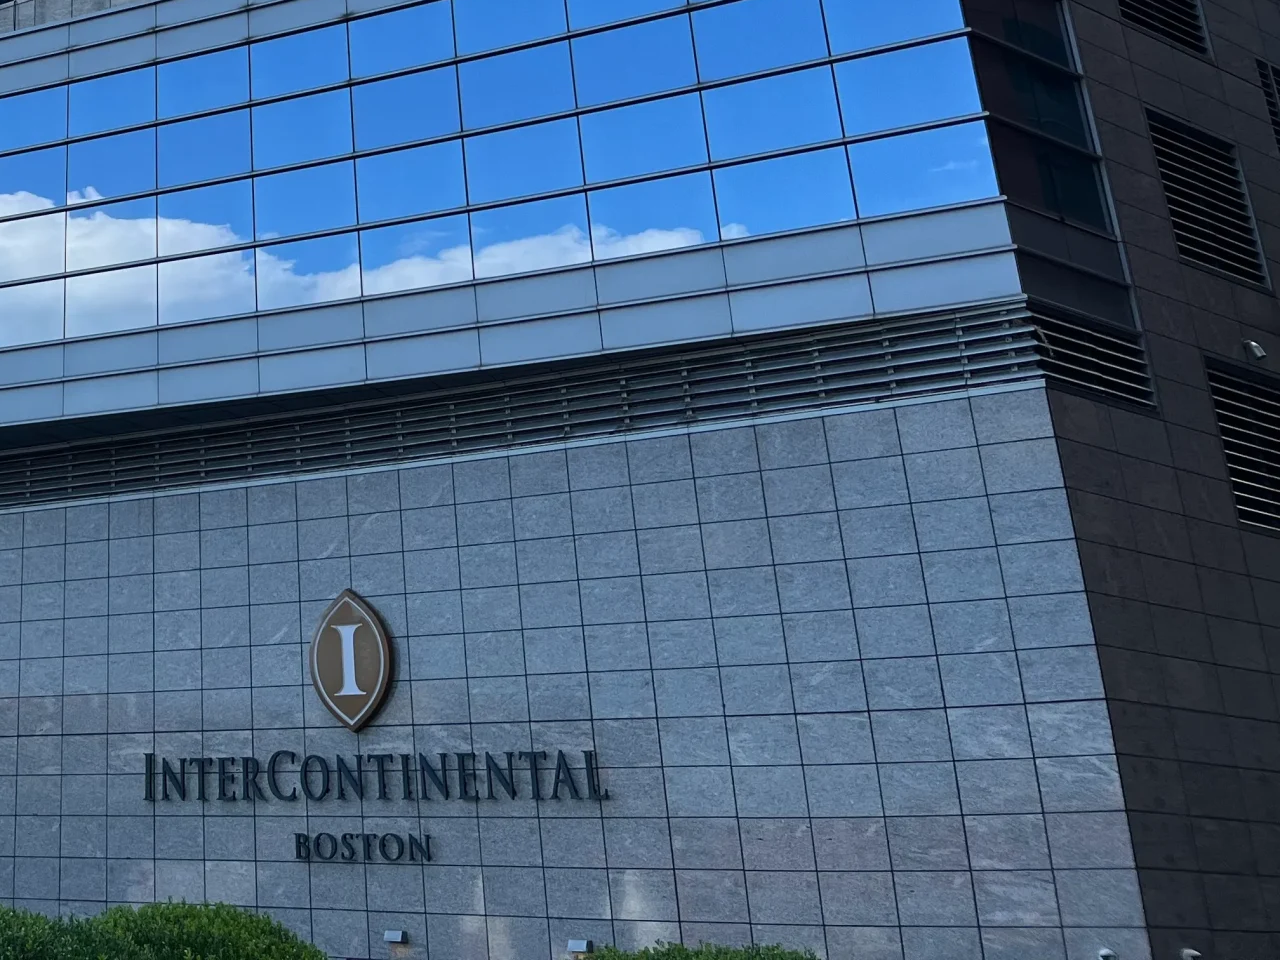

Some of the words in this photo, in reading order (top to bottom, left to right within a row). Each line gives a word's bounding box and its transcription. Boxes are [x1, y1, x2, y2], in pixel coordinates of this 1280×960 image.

[330, 623, 367, 696] I
[143, 749, 610, 802] INTERCONTINENTAL
[294, 832, 433, 863] BOSTON
